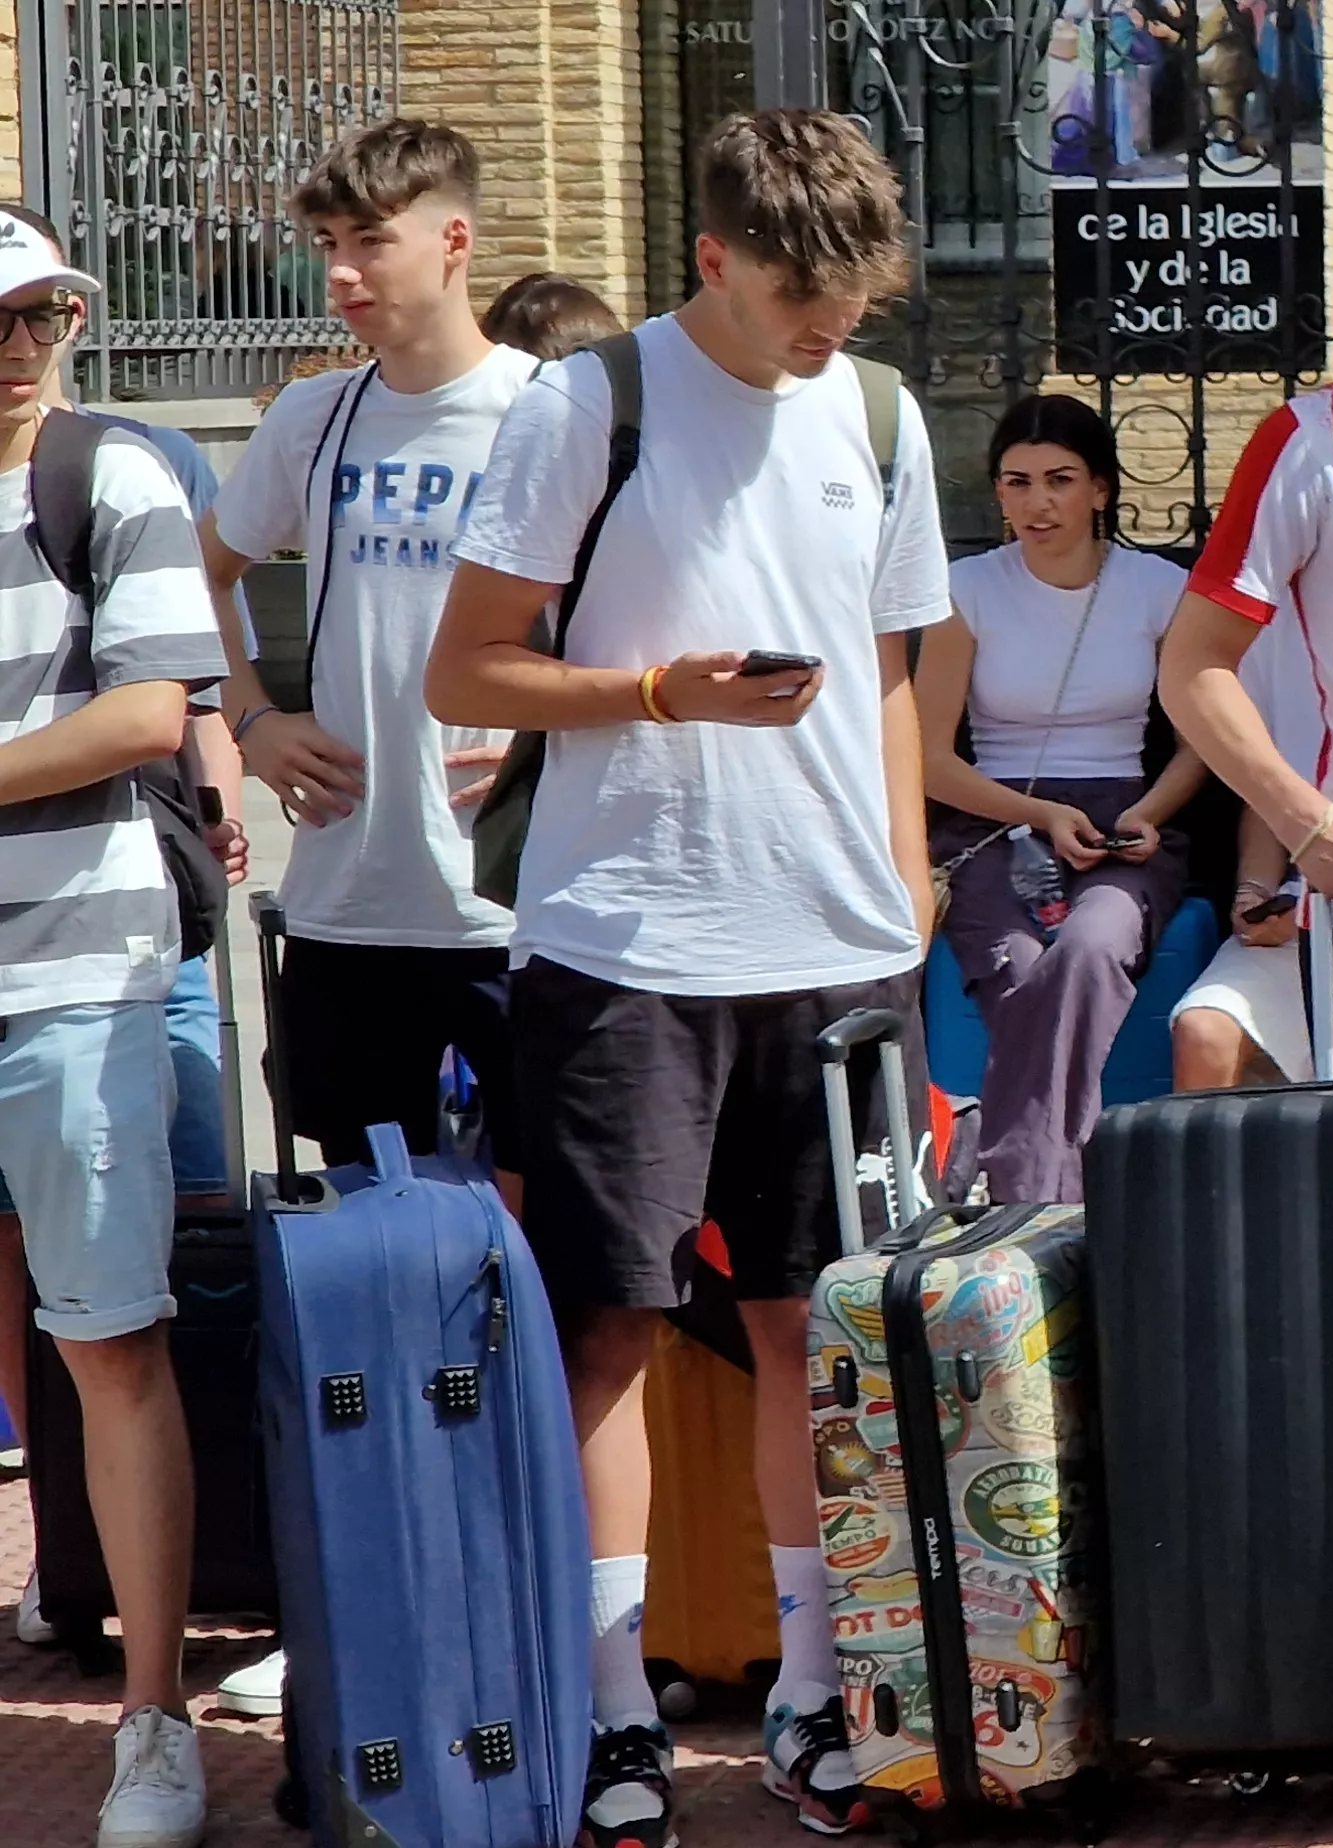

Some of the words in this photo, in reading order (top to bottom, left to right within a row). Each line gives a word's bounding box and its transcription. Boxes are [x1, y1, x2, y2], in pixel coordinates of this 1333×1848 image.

[1137, 203, 1170, 240] la
[1125, 259, 1150, 294] y
[1219, 249, 1252, 285] la
[1107, 295, 1279, 333] Socidad
